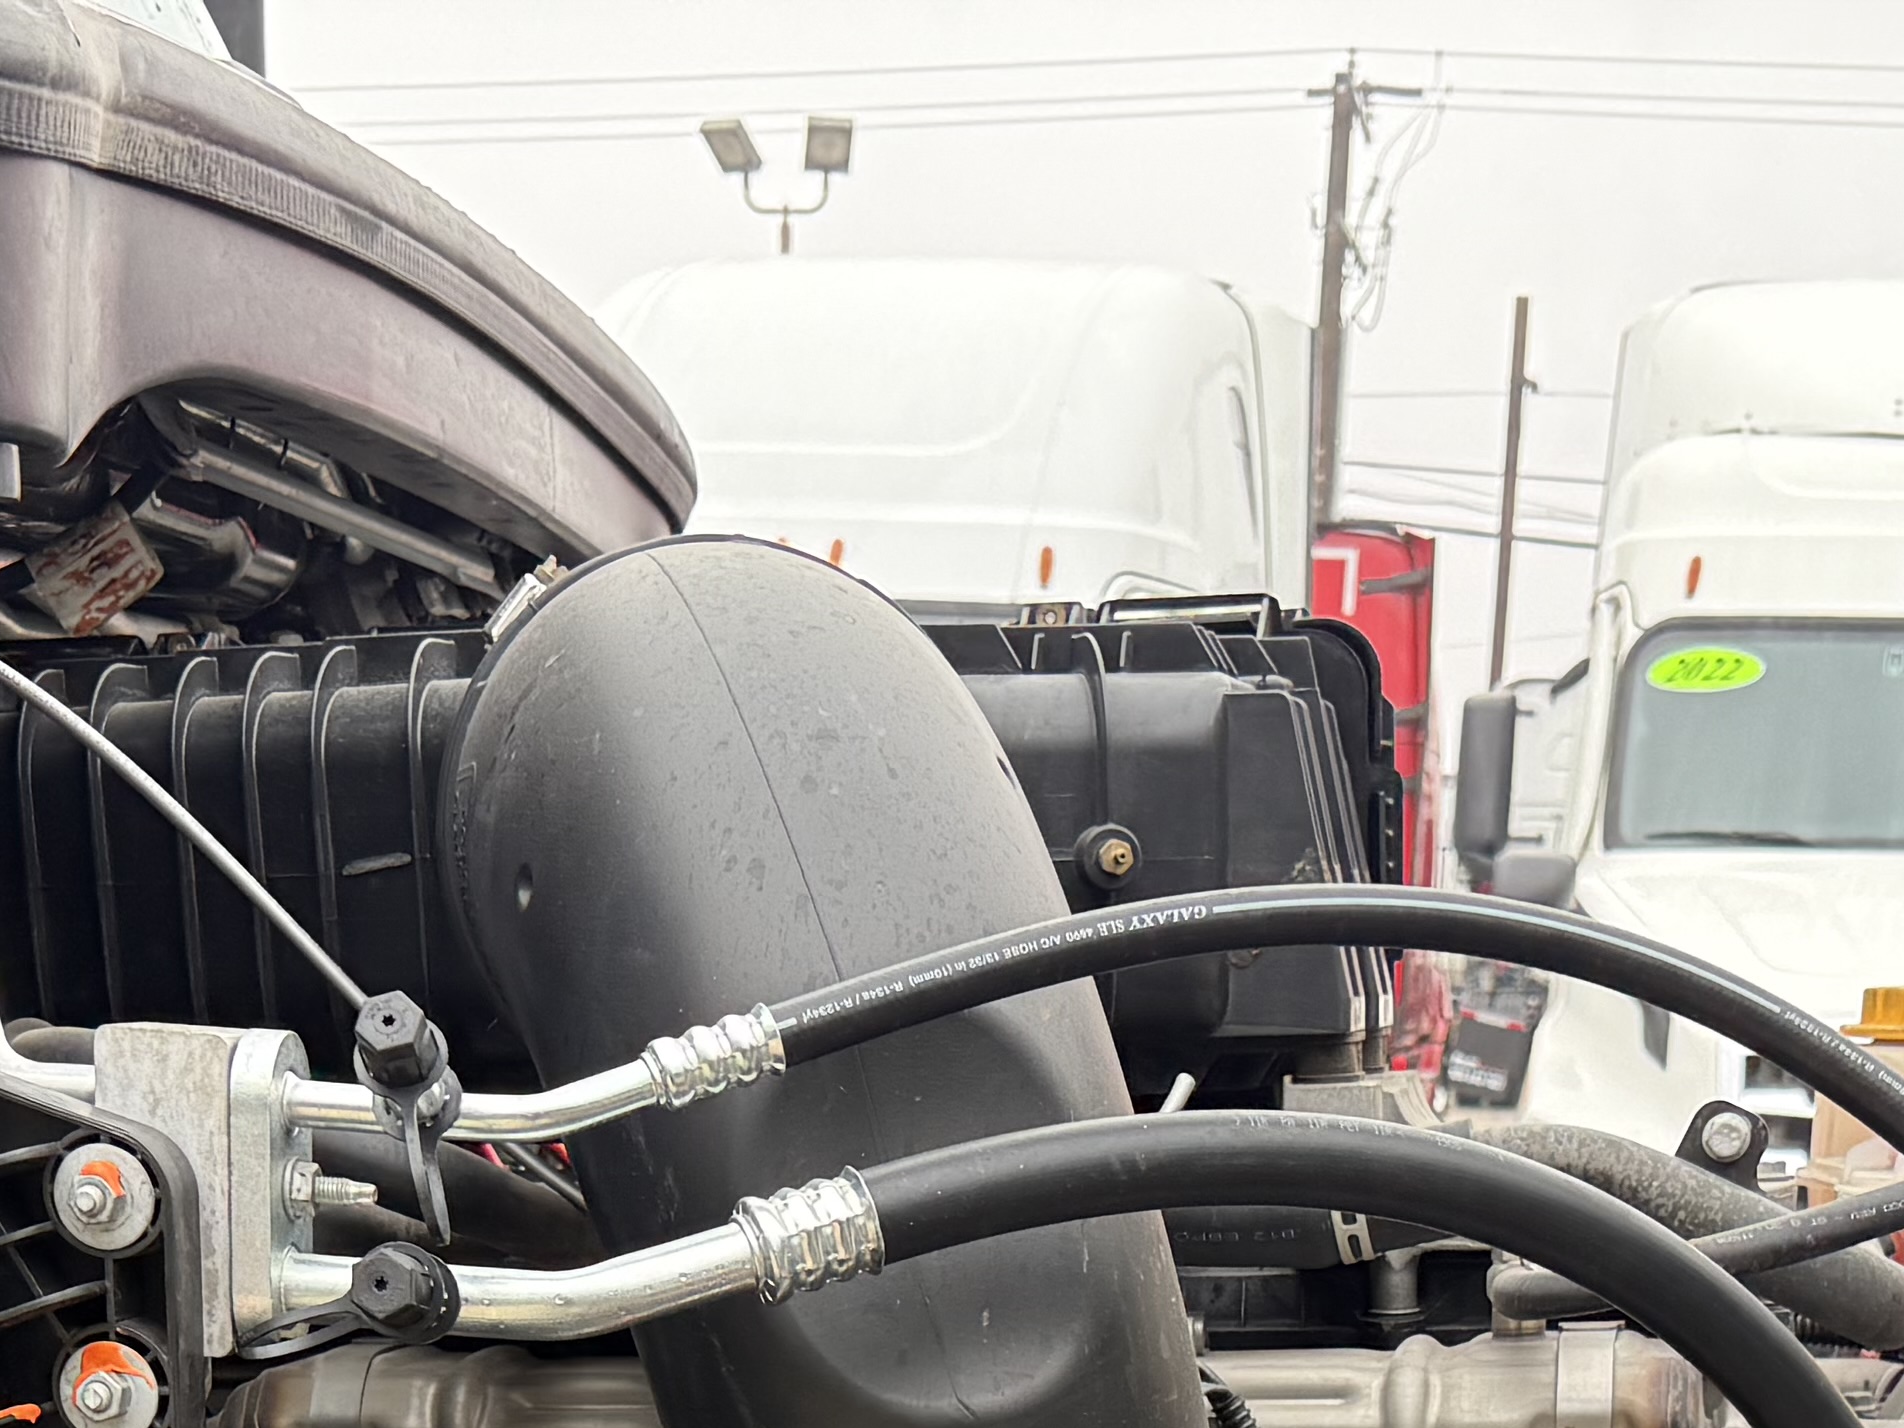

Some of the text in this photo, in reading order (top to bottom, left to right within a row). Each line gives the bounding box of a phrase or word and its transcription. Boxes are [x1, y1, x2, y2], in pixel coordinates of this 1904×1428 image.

[1664, 657, 1744, 683] 2022
[1129, 905, 1207, 930] GALAXY
[1004, 941, 1039, 961] HOSE
[1039, 934, 1062, 951] A/C
[908, 962, 953, 989] (10mm)
